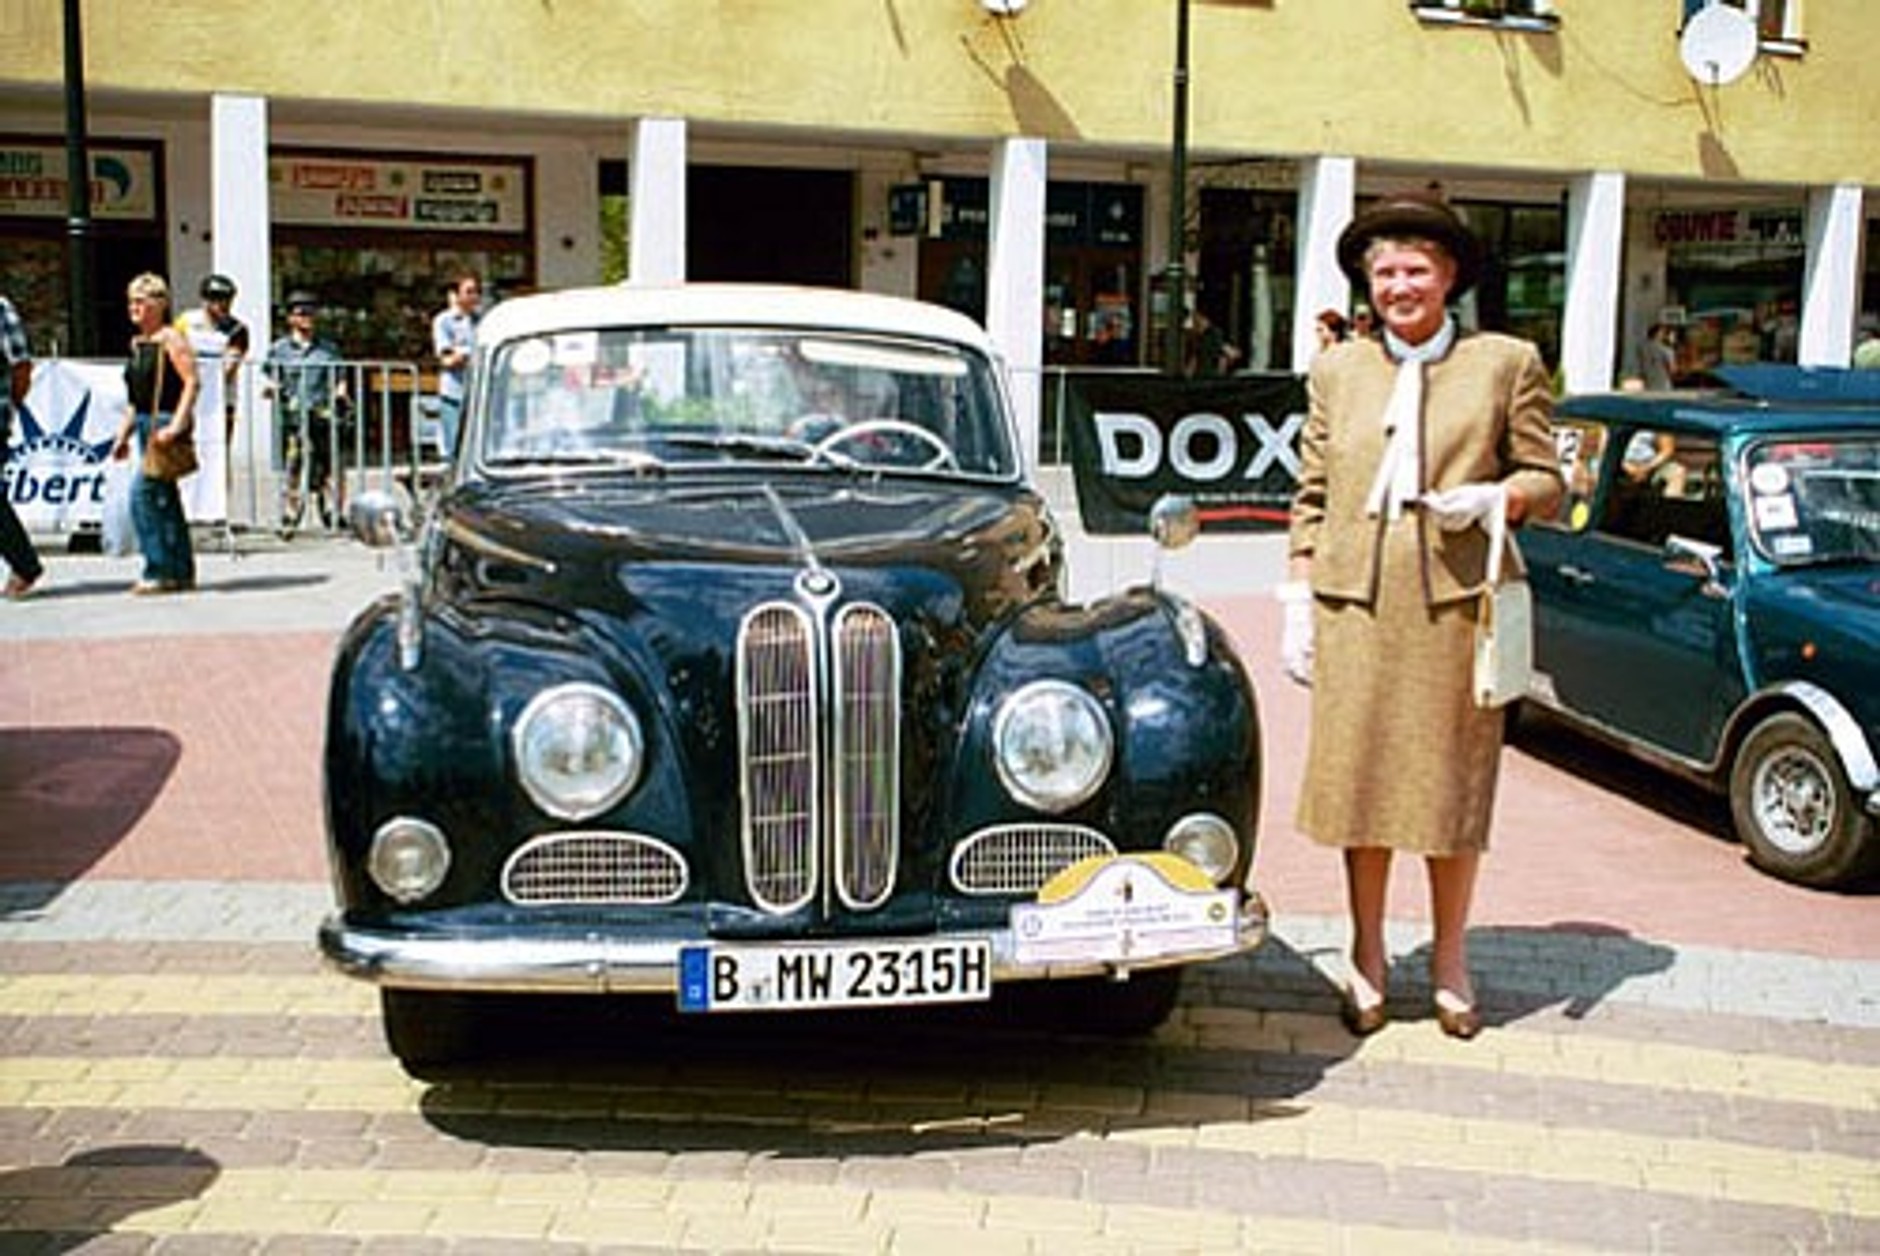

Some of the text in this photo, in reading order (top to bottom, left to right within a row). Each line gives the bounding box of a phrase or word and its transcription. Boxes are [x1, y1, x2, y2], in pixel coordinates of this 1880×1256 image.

[1094, 412, 1306, 481] DOX
[712, 946, 987, 1002] B MW 2315H
